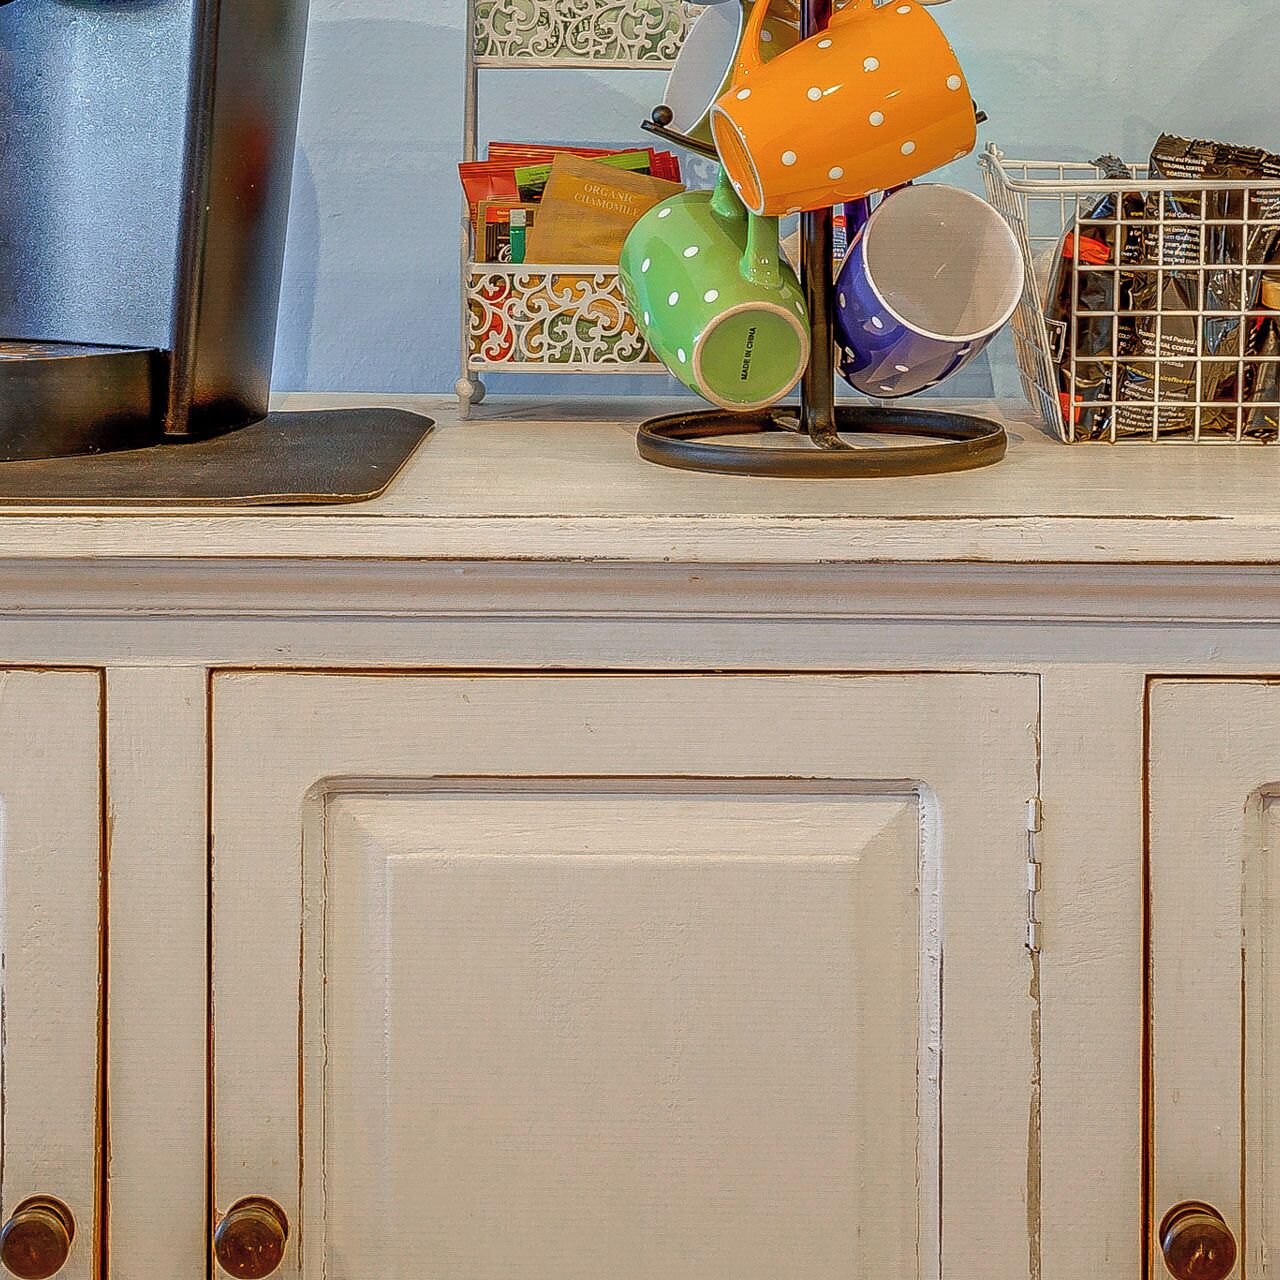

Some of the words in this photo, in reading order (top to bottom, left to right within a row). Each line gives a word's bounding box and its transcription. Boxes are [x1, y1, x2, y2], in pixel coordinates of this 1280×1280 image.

[584, 182, 635, 204] ORGANIC
[573, 192, 640, 216] CHAMOMILE
[746, 327, 757, 350] CHINA
[1171, 344, 1196, 353] COFFEE
[1173, 336, 1195, 345] Packed
[744, 350, 752, 358] IN
[740, 359, 751, 380] MADE
